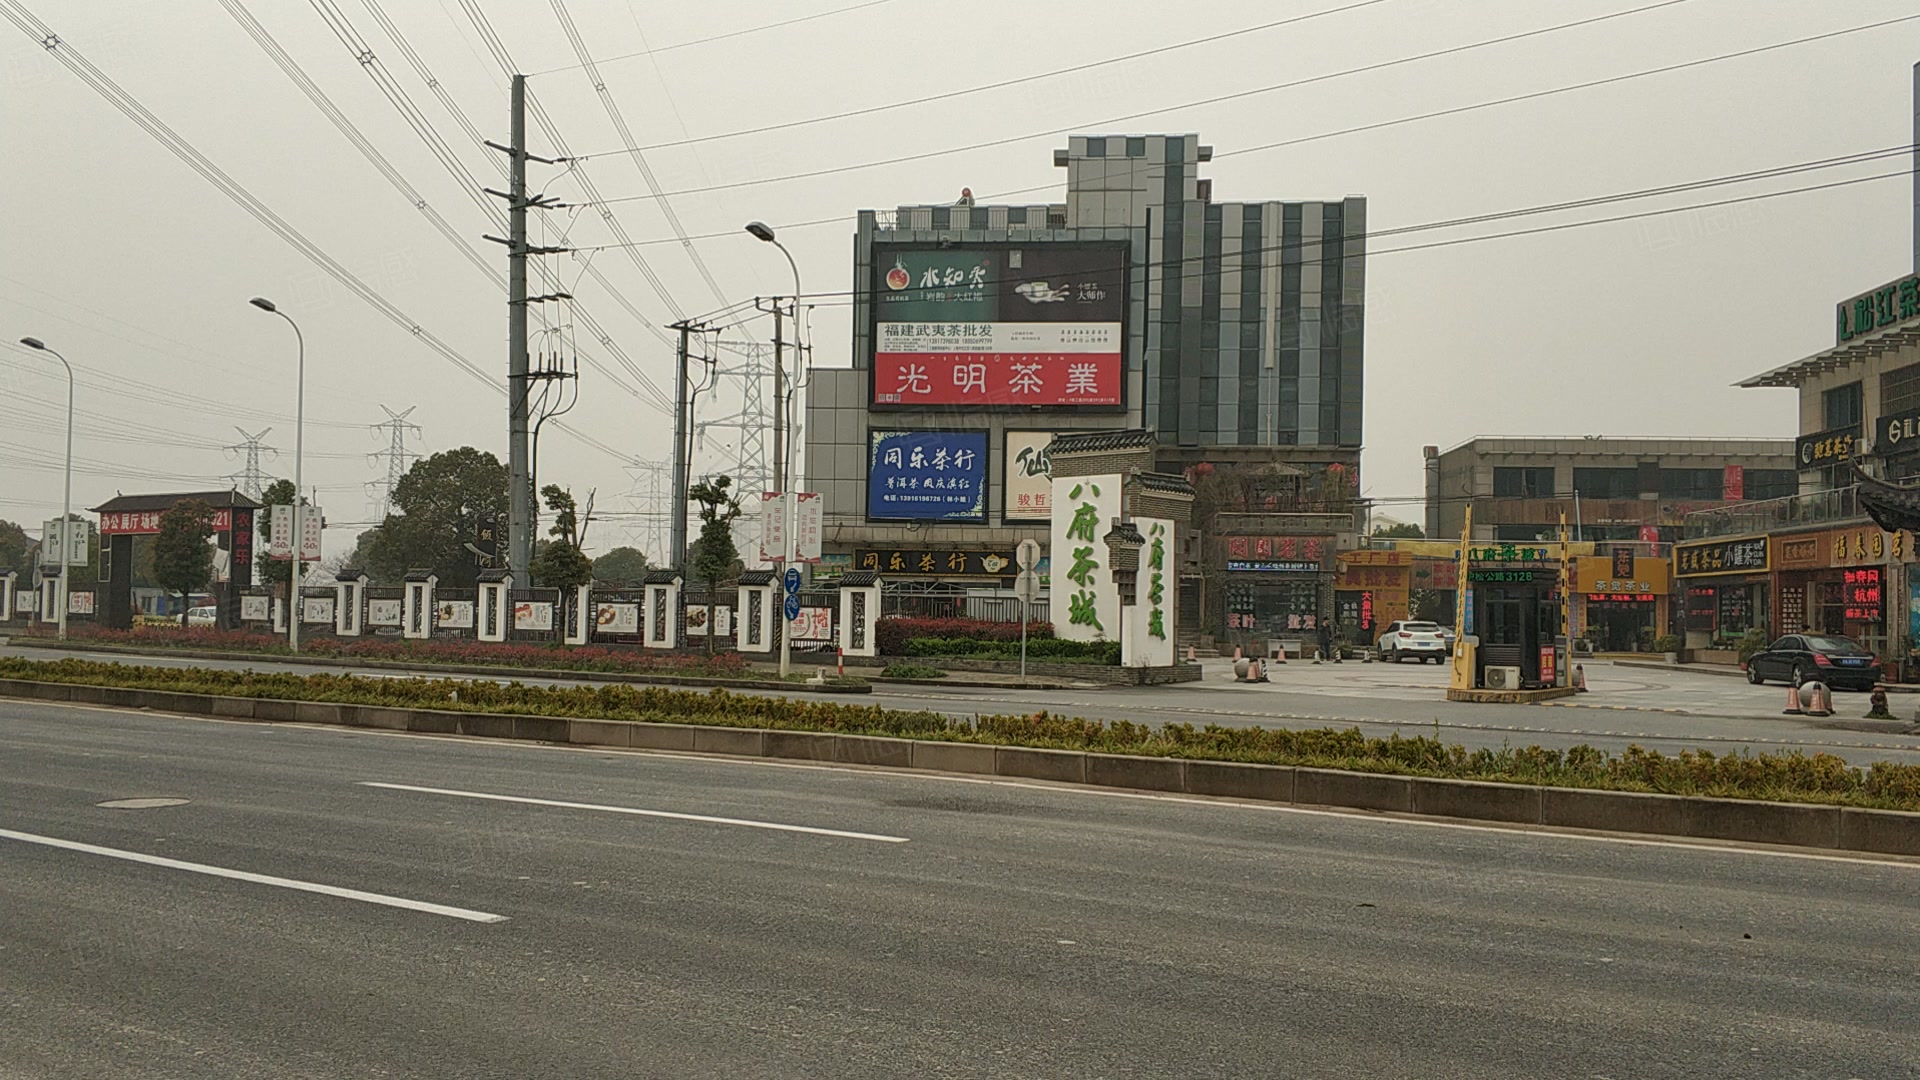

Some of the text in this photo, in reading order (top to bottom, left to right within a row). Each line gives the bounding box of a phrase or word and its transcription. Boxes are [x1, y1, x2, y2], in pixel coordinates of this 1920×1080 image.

[884, 324, 993, 337] 福建武夷茶批发
[897, 362, 1099, 395] 光明茶業
[884, 446, 976, 471] 同乐茶行
[885, 476, 919, 489] 普洱茶
[101, 514, 119, 530] 办公
[863, 552, 968, 571] 同乐茶行
[1066, 483, 1104, 632] 八府茶城
[1854, 588, 1878, 602] 杭州
